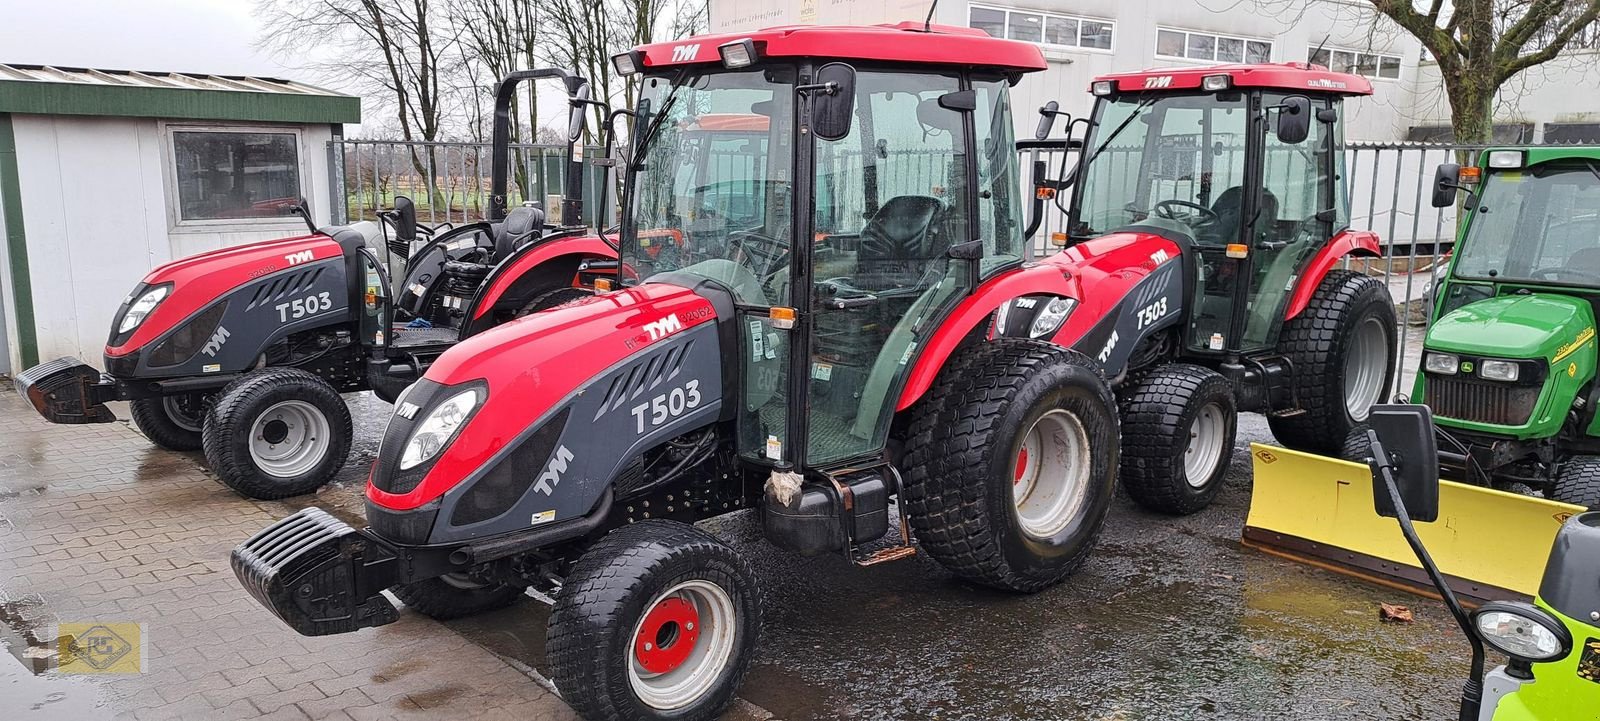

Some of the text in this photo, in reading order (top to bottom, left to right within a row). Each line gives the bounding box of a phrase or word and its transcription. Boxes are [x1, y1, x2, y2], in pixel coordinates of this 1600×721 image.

[672, 44, 700, 62] TYM
[1145, 76, 1172, 88] TYM
[285, 250, 314, 265] TYM
[1150, 249, 1168, 265] TYM
[275, 292, 332, 322] T503
[1016, 298, 1037, 309] TYM
[1137, 297, 1167, 330] T503
[643, 313, 681, 340] TYM
[201, 326, 231, 358] TYM
[1098, 329, 1119, 363] TYM
[397, 402, 420, 420] TYM
[631, 379, 701, 434] T503
[533, 444, 575, 497] TYM
